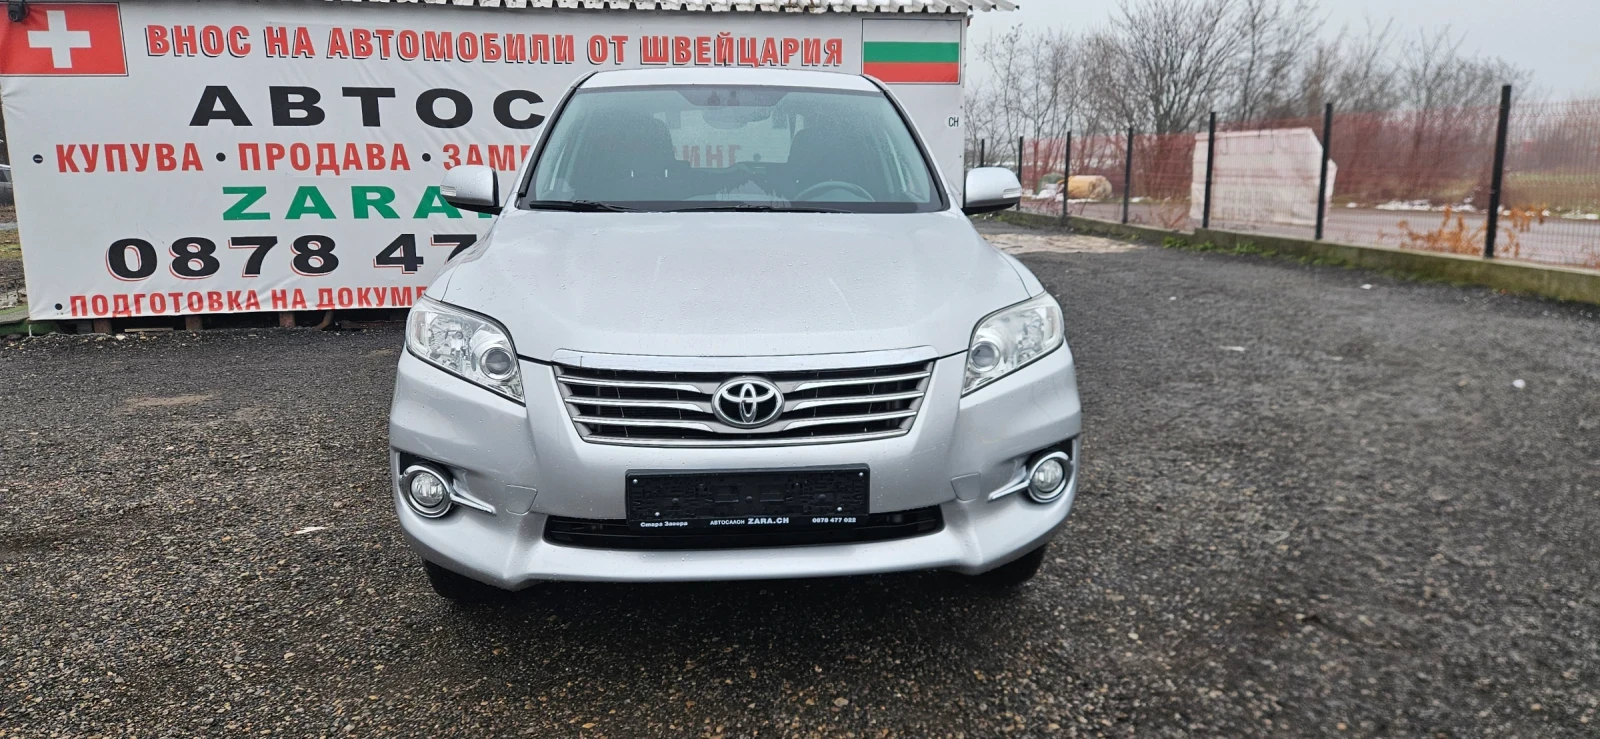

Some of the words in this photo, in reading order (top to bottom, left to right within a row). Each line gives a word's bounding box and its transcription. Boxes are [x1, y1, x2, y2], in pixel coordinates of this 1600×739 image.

[147, 24, 253, 58] ВНОС
[265, 25, 317, 58] НА
[328, 27, 576, 64] АВТОМОБИЛИ
[587, 34, 630, 65] ОТ
[640, 32, 844, 68] ШВЕЙЦАРИЯ
[948, 116, 960, 128] CH
[56, 142, 204, 173] КУПУВА
[237, 142, 411, 176] ПРОДАВА
[105, 234, 339, 279] 0878
[69, 288, 262, 319] ПОДГОТОВКА
[270, 287, 309, 311] НА
[747, 517, 790, 525] ZARA.CH
